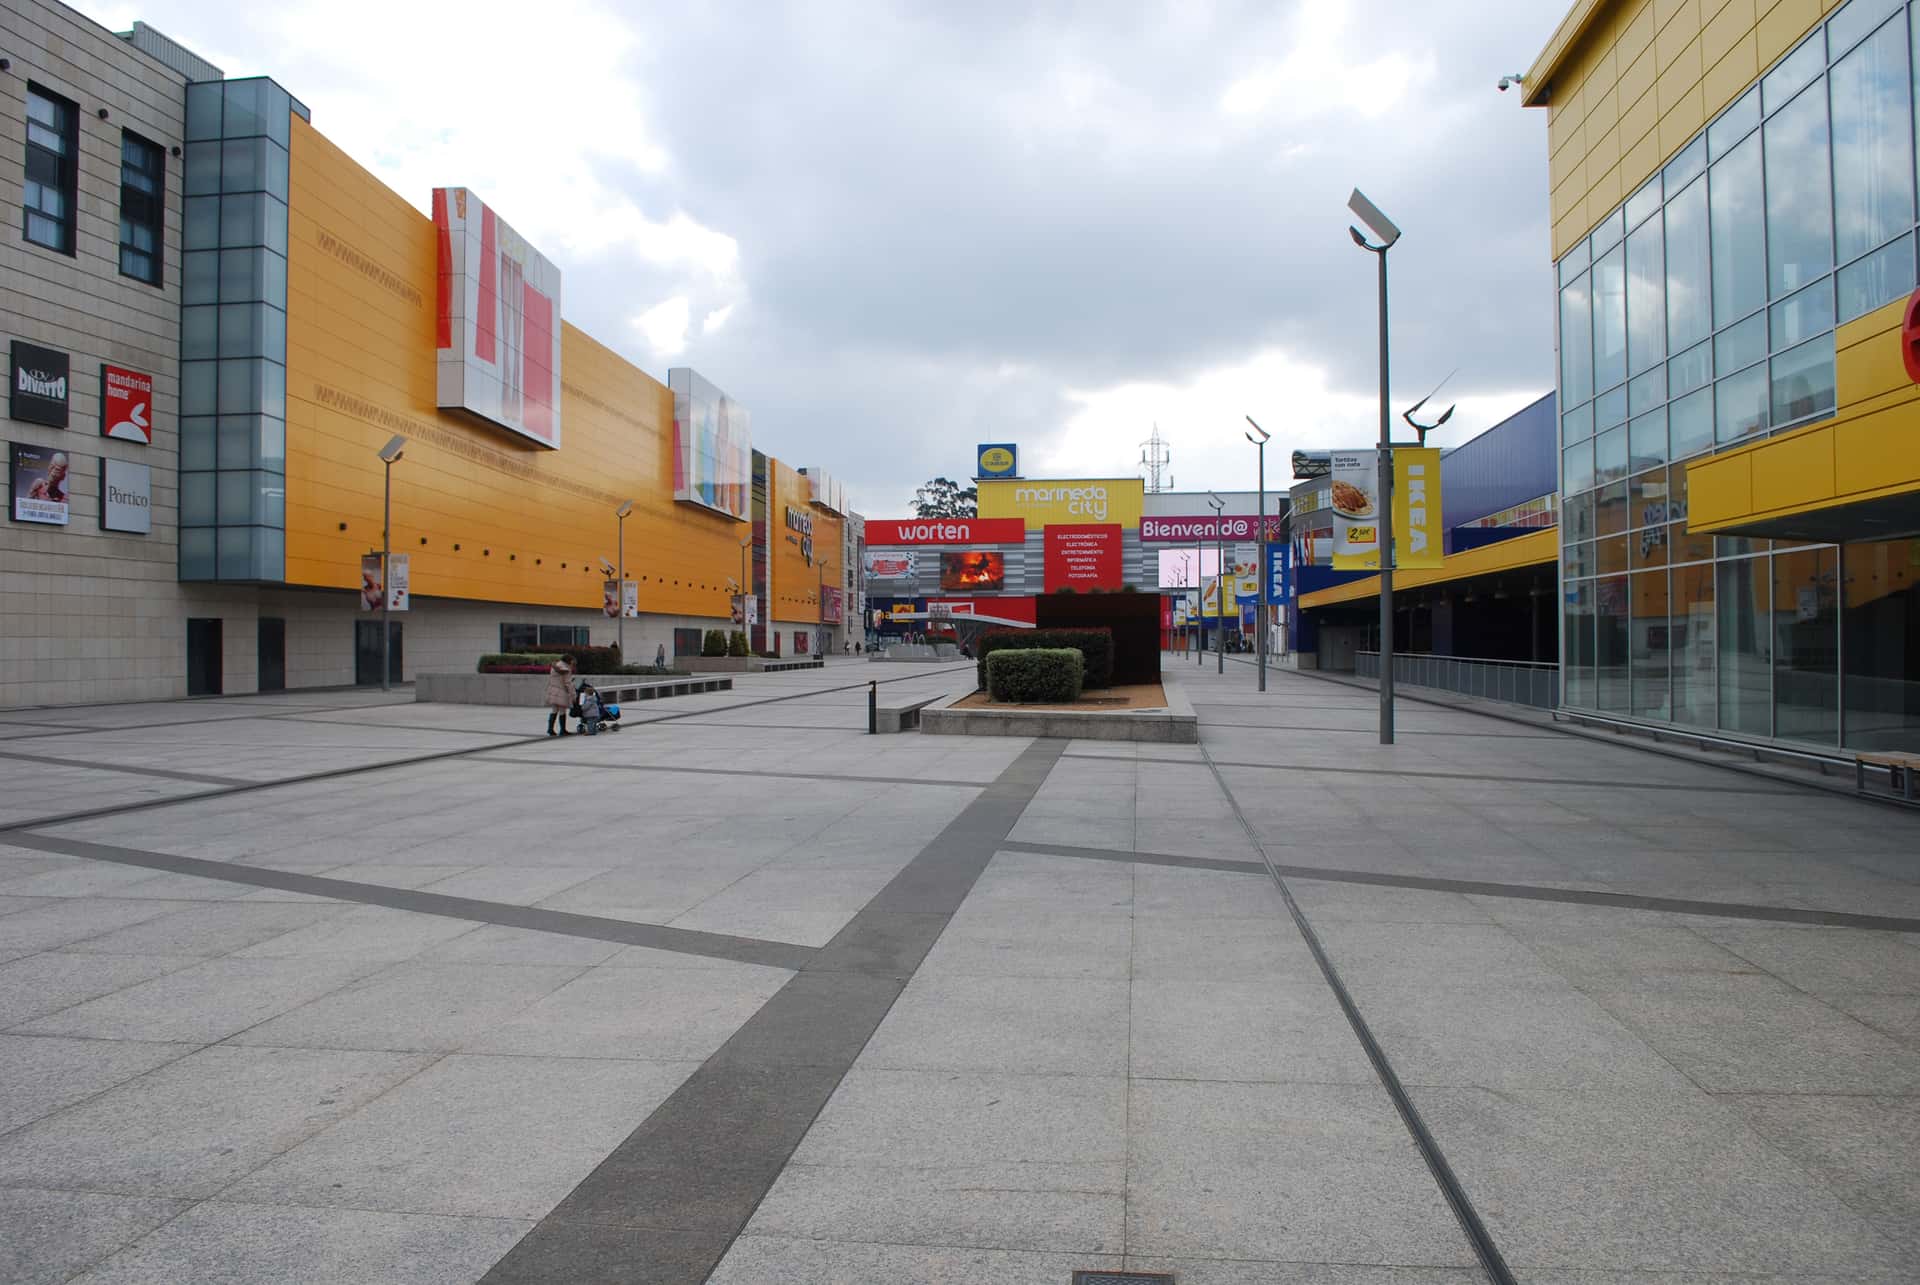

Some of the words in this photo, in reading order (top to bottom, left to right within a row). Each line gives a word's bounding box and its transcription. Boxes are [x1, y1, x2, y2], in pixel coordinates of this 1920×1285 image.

[18, 366, 66, 399] DIVATTO
[107, 371, 151, 393] mandarina
[107, 383, 129, 400] home
[108, 485, 148, 508] Pórtico
[1015, 486, 1106, 502] marineda
[1068, 500, 1107, 521] city
[1408, 465, 1428, 555] IKEA
[898, 522, 970, 540] worten
[1142, 519, 1248, 537] Bienvenid@
[1272, 552, 1284, 598] IKEA
